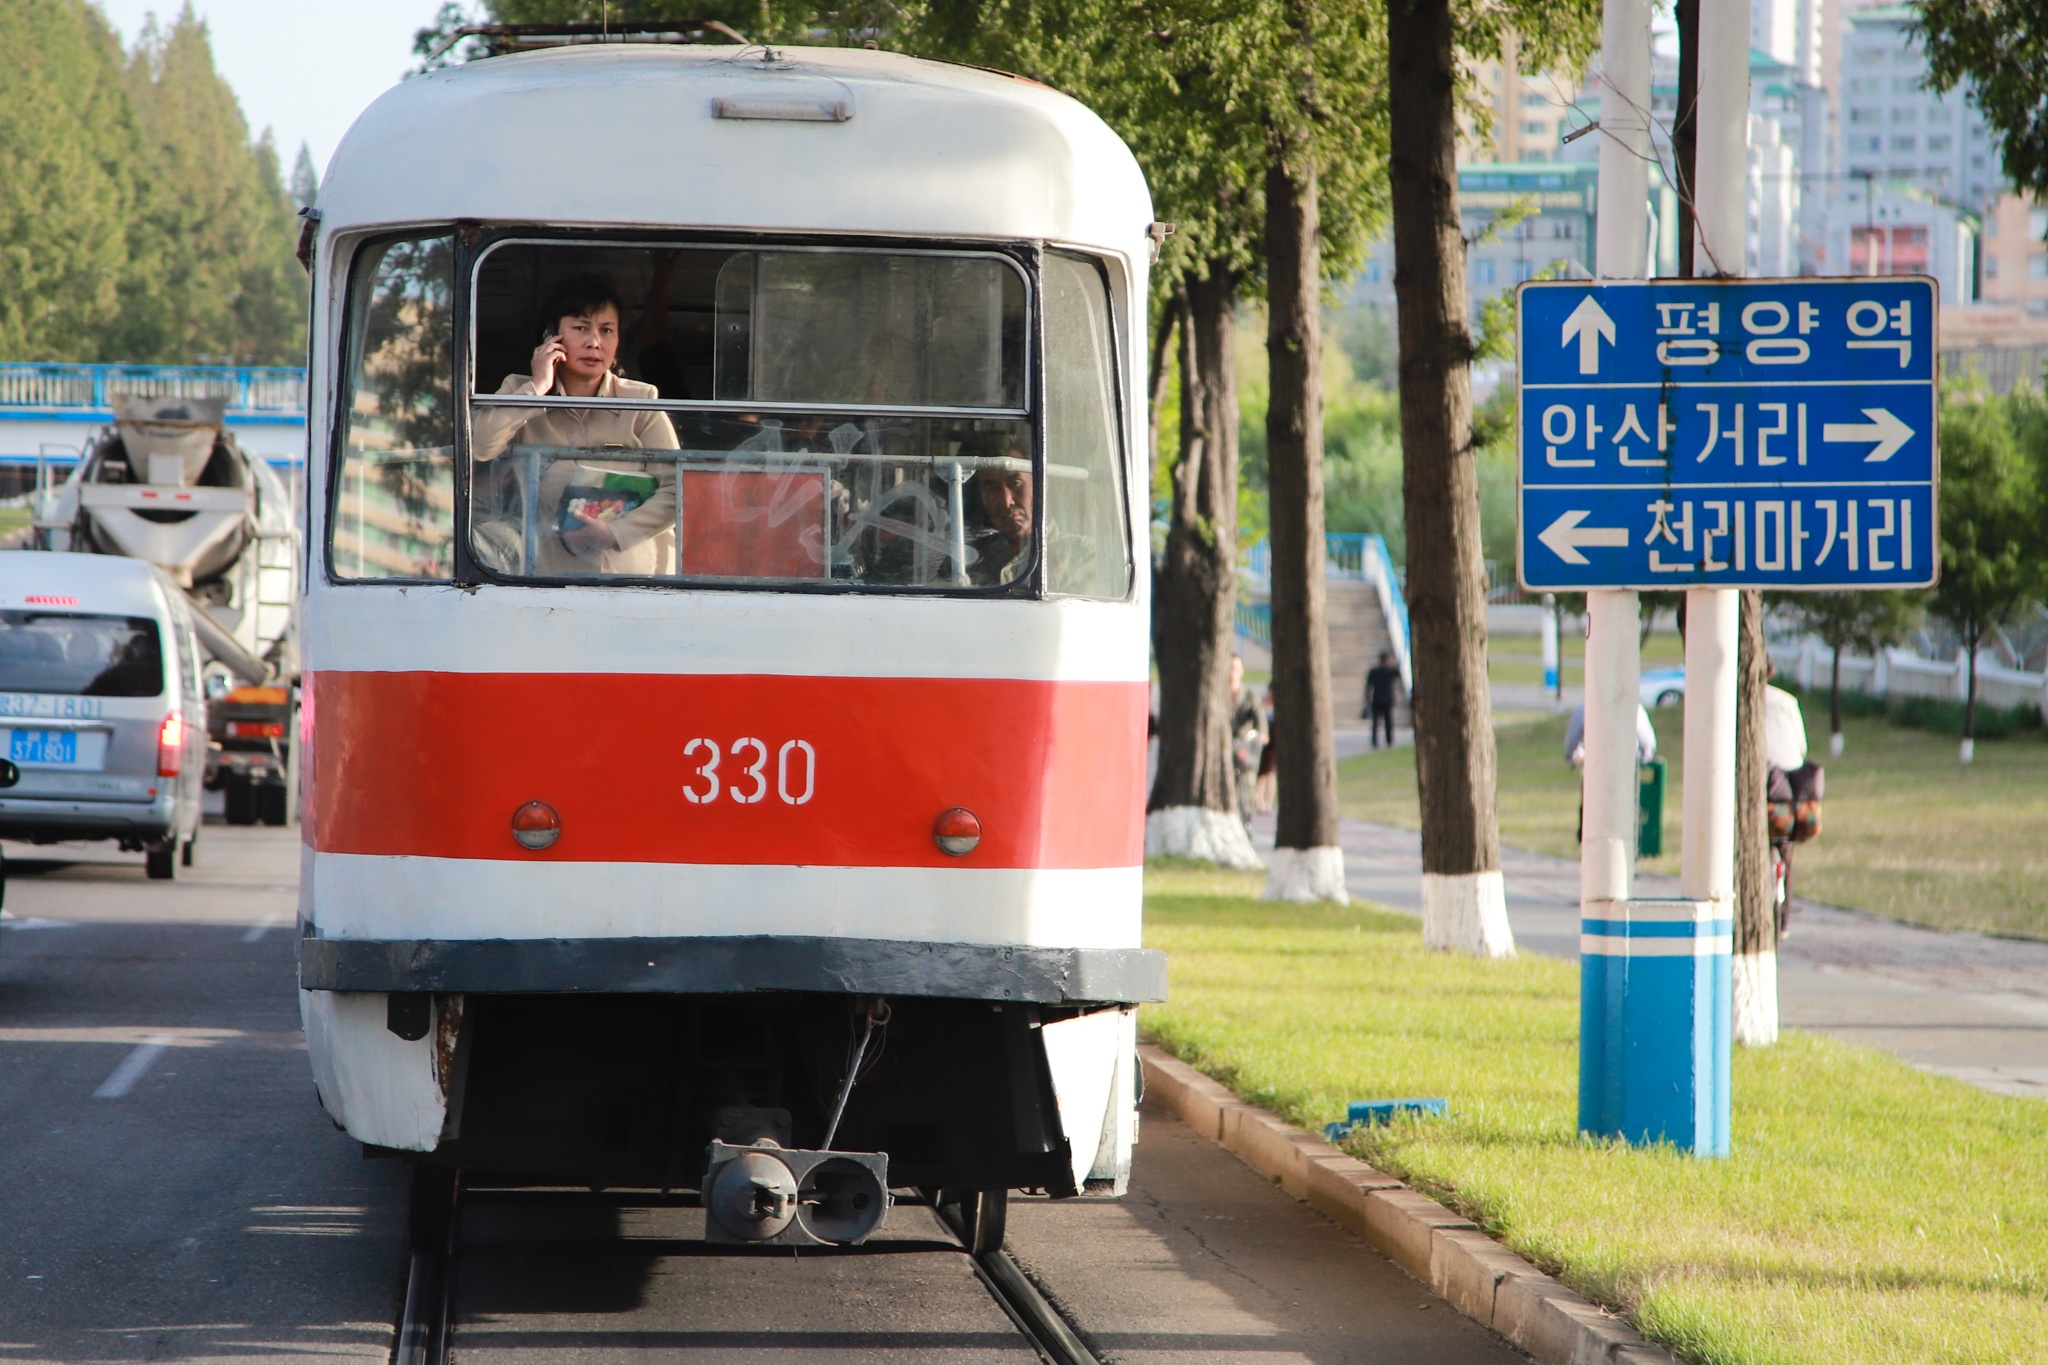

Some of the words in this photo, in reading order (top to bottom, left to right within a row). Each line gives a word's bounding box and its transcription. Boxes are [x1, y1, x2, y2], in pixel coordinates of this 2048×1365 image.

[1542, 403, 1677, 468] 안산
[1696, 402, 1807, 467] 거리
[682, 737, 815, 805] 330
